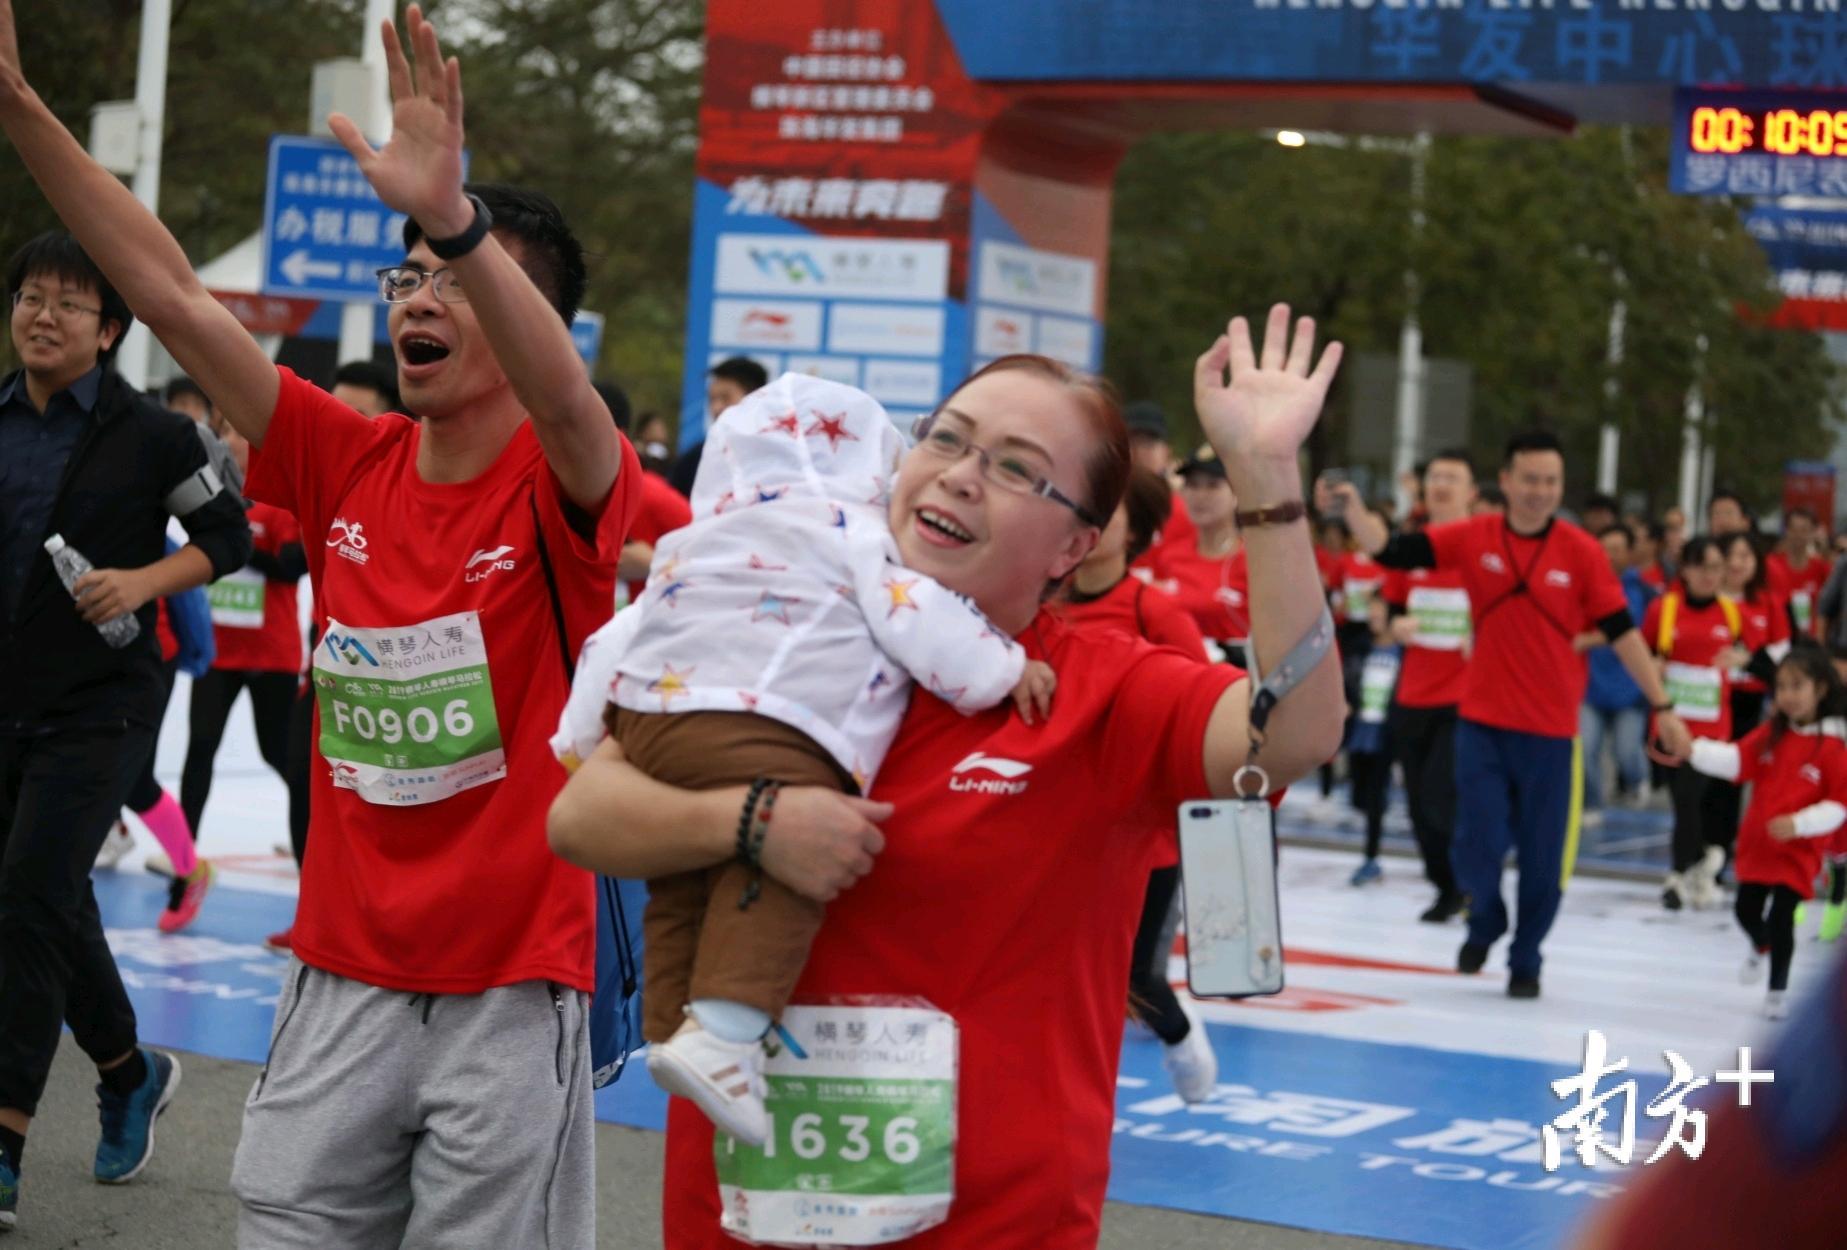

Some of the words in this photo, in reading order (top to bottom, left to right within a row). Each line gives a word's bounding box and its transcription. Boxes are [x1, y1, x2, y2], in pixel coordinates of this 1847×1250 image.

[376, 625, 465, 657] 横琴人寿
[440, 645, 466, 659] LIFE
[332, 699, 475, 744] F0906
[815, 1021, 928, 1046] 横琴人寿
[727, 1112, 921, 1164] 1636
[1357, 1151, 1628, 1199] TOUR
